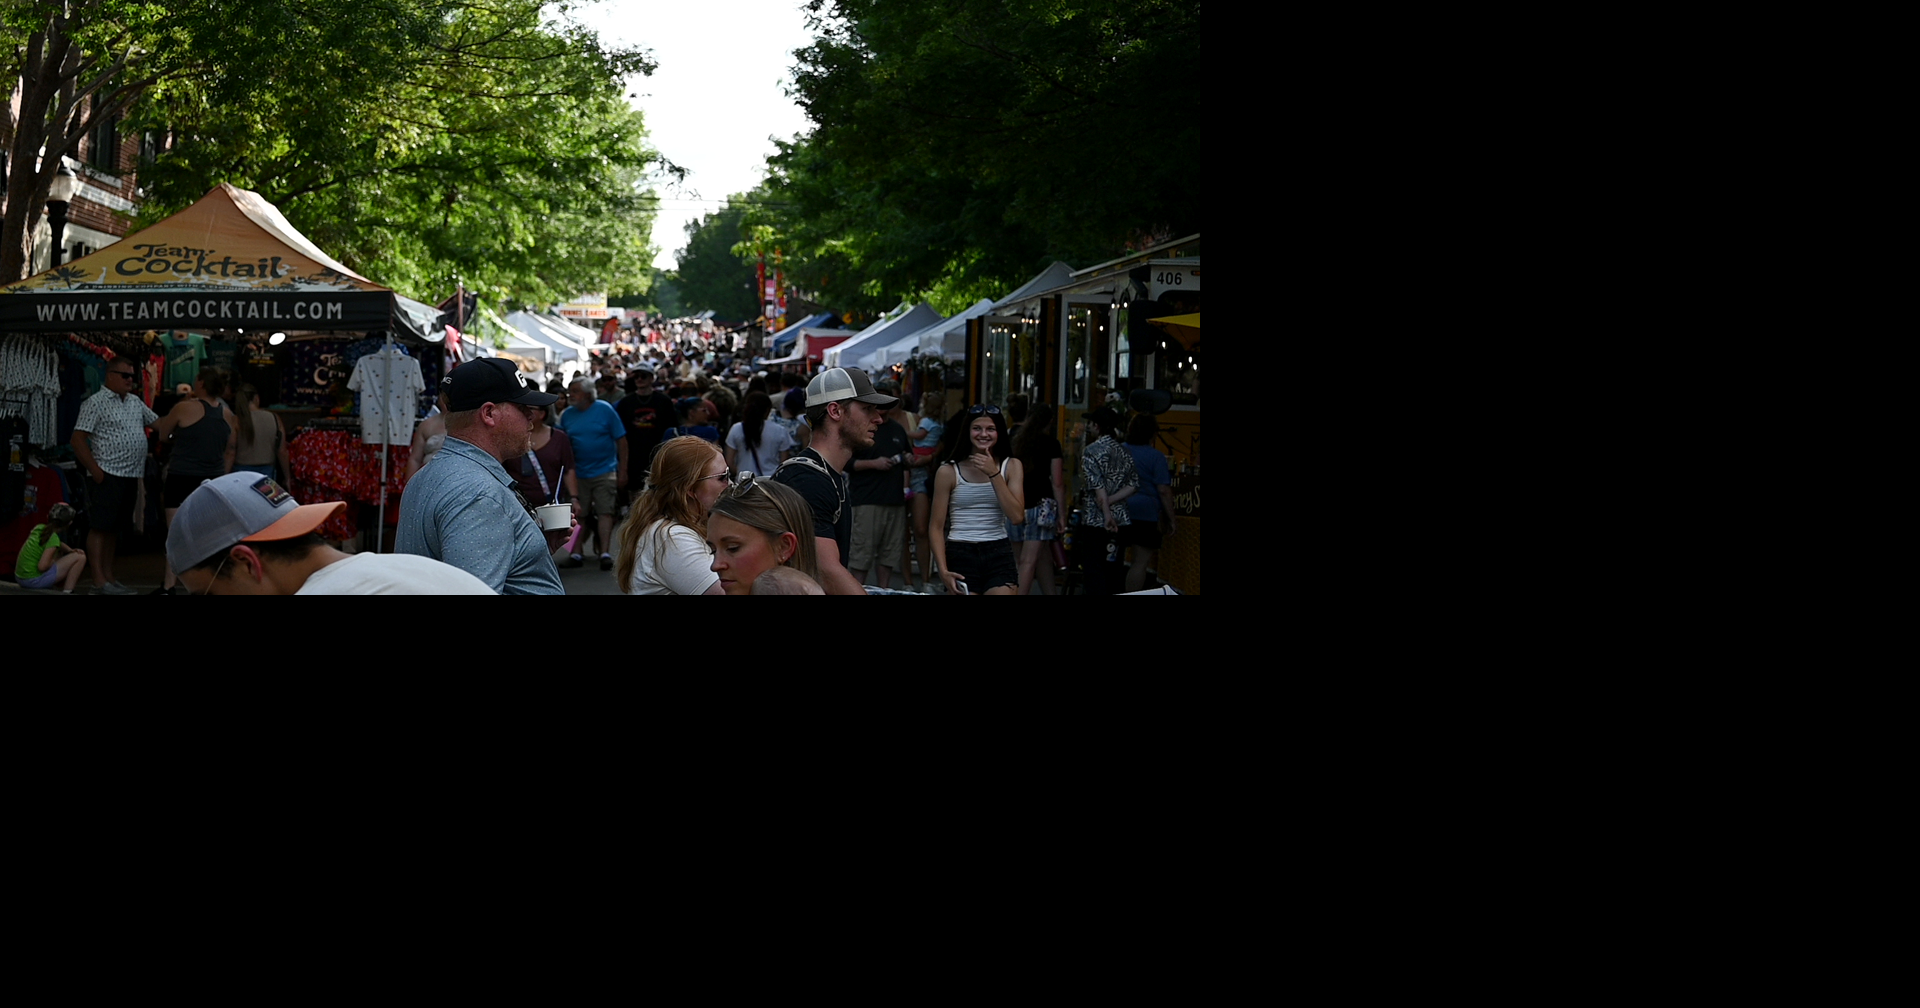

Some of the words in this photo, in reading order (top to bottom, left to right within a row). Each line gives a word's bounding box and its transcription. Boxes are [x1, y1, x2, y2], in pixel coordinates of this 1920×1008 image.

[133, 243, 204, 259] Team
[115, 256, 282, 278] Cocktail
[1157, 272, 1182, 285] 406
[36, 300, 343, 322] WWW.TEAMCOCKTAIL.COM
